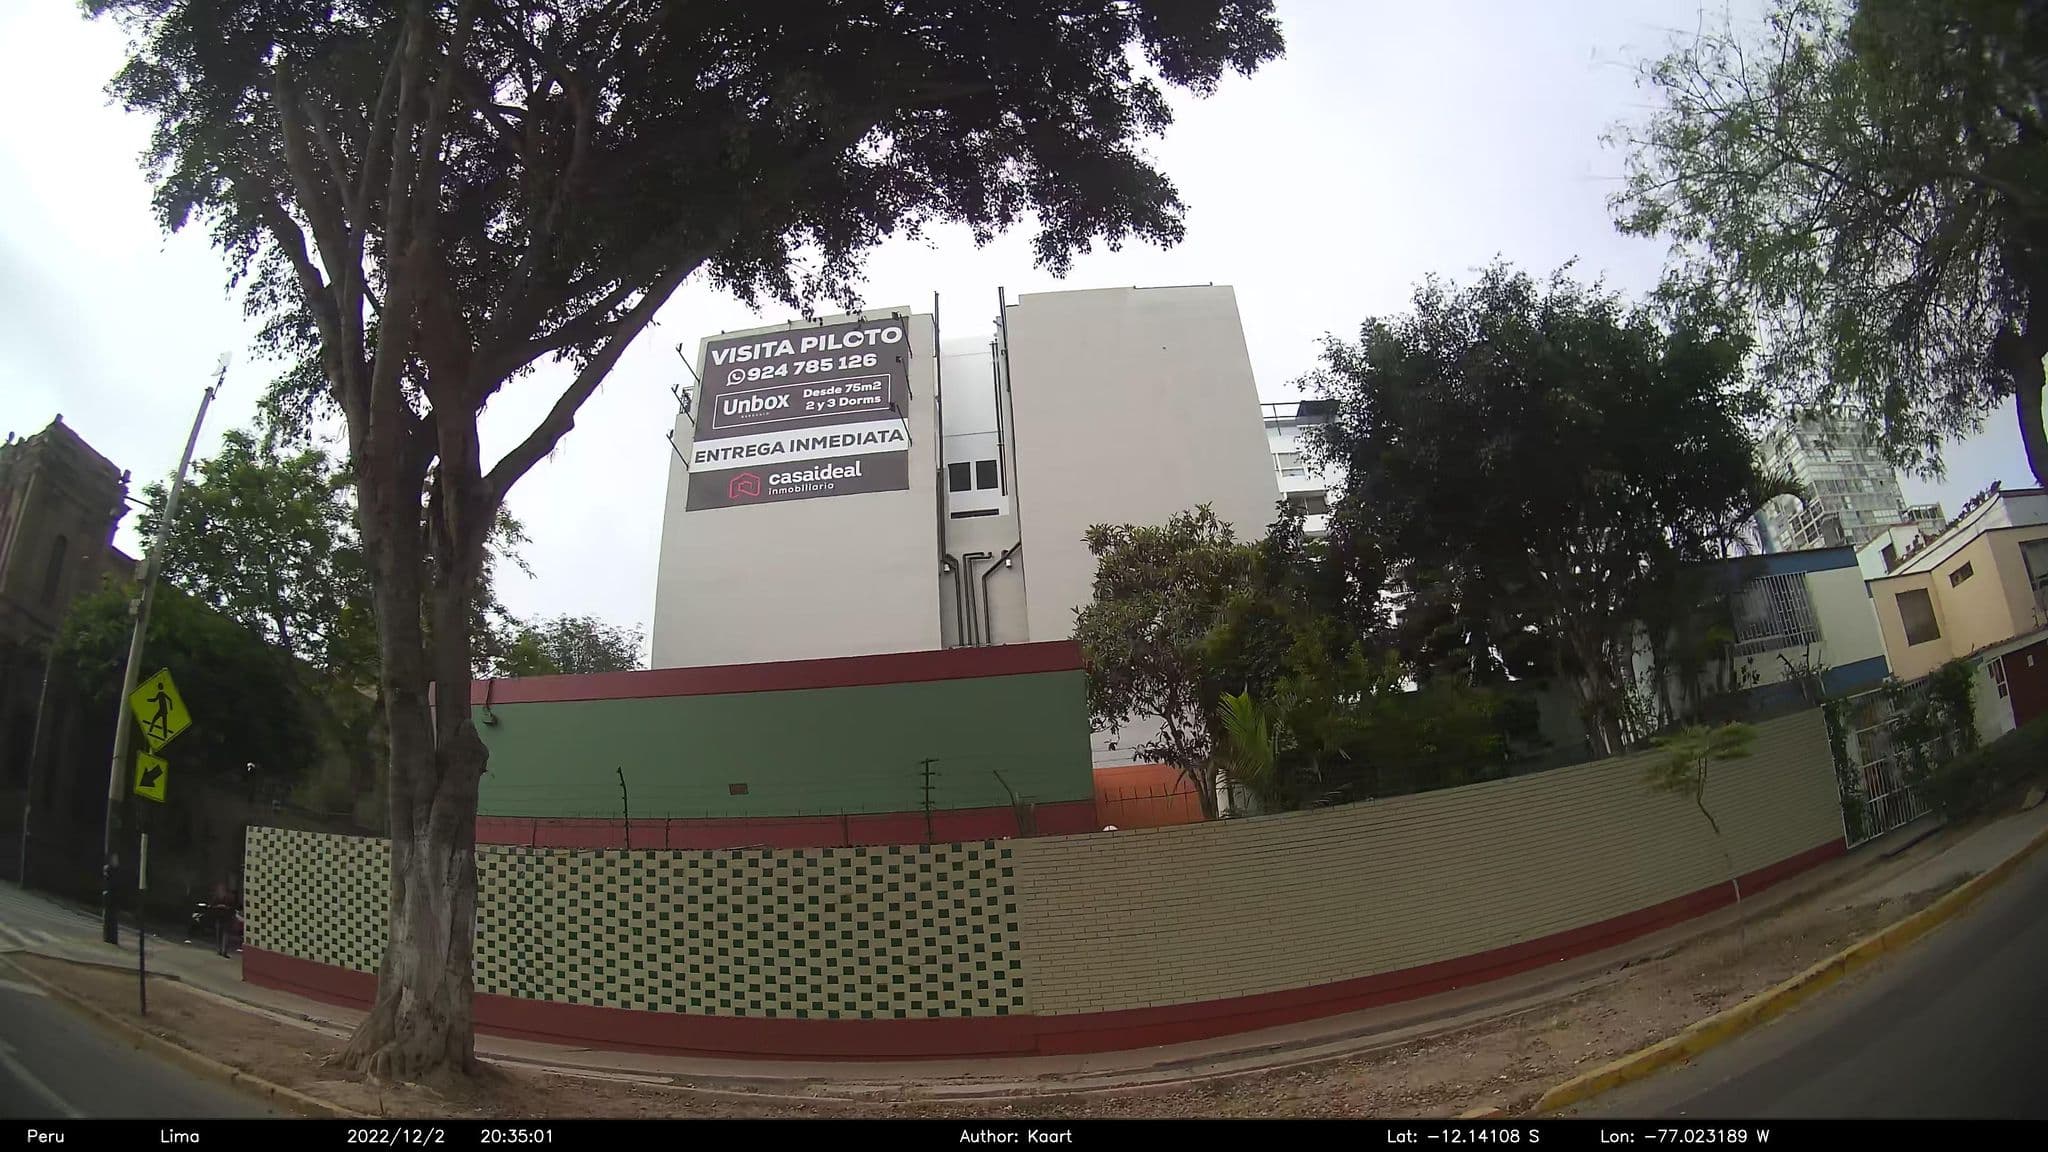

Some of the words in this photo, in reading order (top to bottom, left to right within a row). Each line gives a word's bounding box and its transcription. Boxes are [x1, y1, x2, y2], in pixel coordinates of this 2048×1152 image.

[711, 339, 795, 366] VISITA
[800, 326, 903, 353] PILOTO
[747, 364, 789, 381] 924
[793, 358, 833, 376] 785
[838, 353, 878, 370] 126
[803, 385, 842, 398] Desde
[845, 381, 882, 393] 75m2
[723, 392, 790, 416] Unbox
[806, 401, 815, 411] 2
[817, 402, 825, 412] y
[827, 398, 836, 408] 3
[839, 394, 881, 407] Dorms
[694, 440, 785, 464] ENTREGA
[789, 428, 905, 453] INMEDIATA
[768, 460, 862, 486] casaideal
